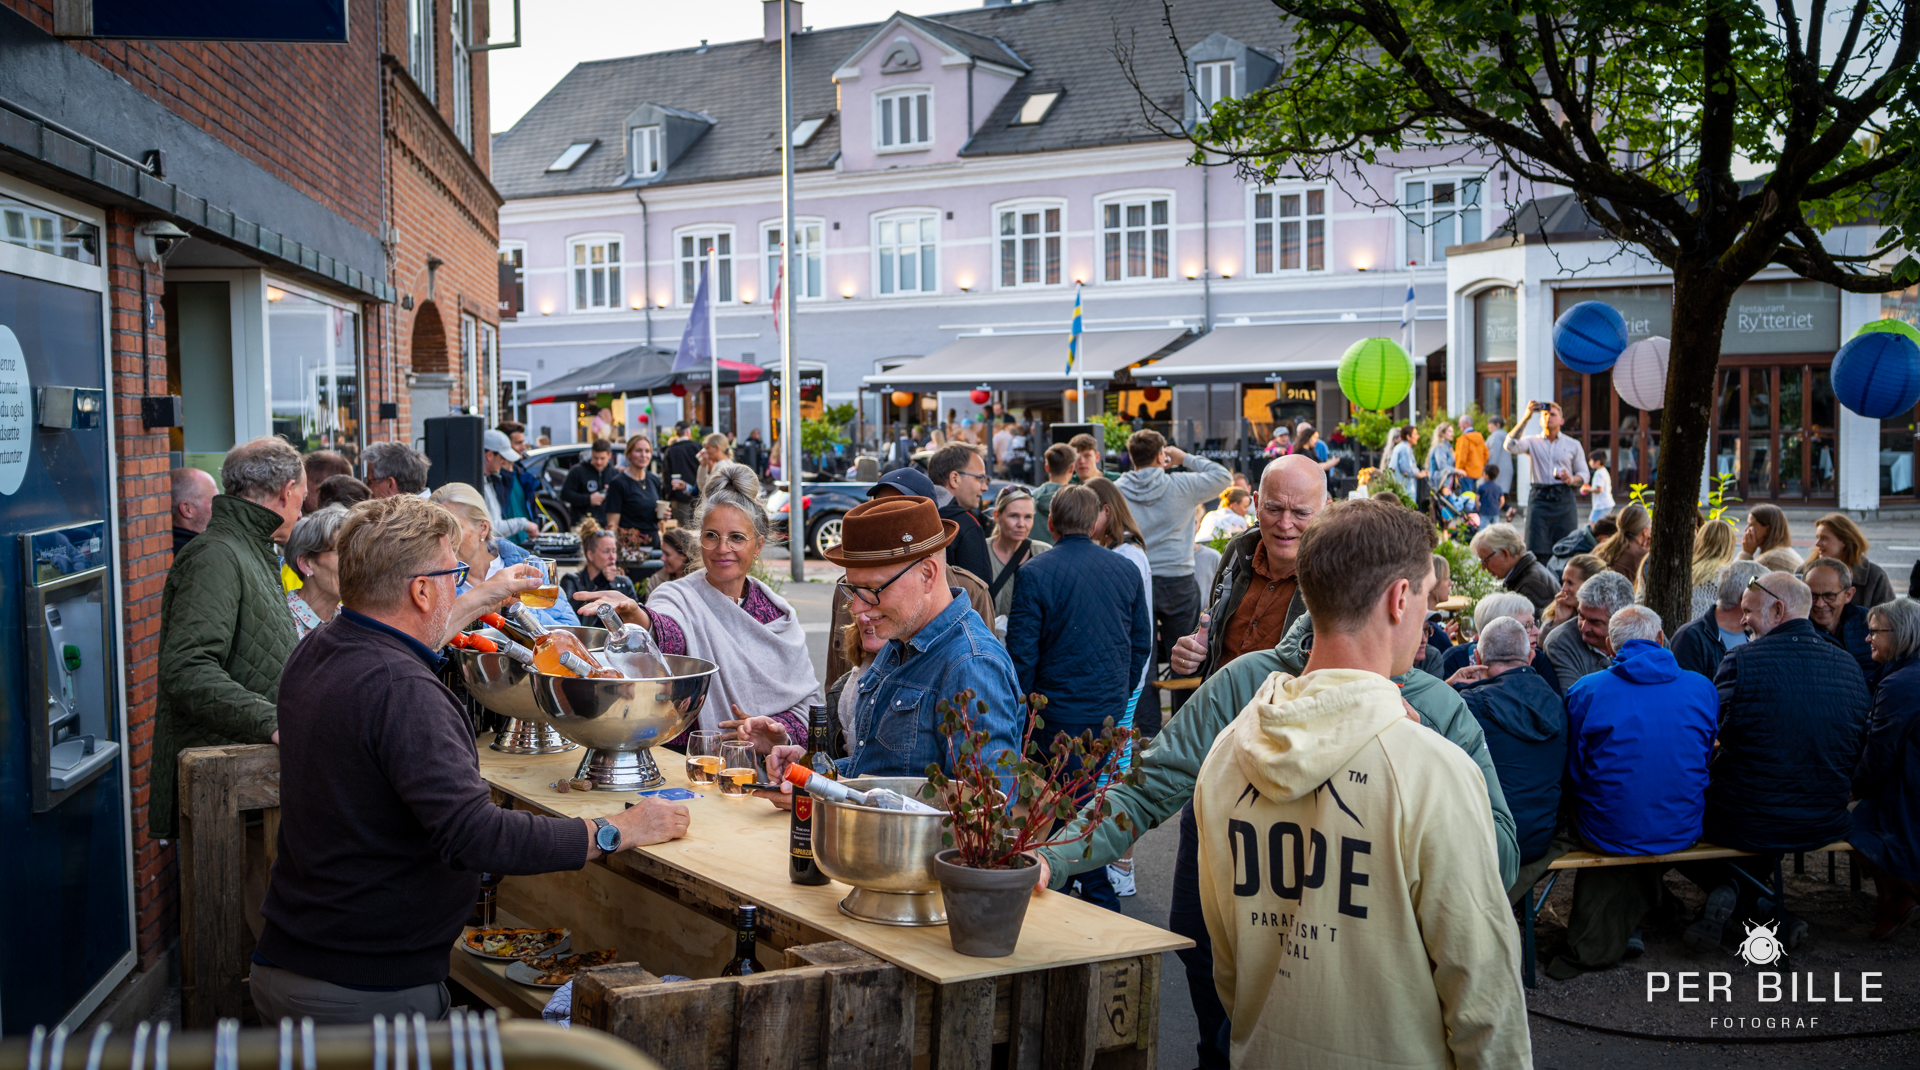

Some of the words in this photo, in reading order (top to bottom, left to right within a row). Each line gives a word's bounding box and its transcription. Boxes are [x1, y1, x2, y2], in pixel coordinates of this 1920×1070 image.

[1739, 304, 1785, 313] Restaurant
[0, 358, 16, 371] enne
[0, 380, 18, 394] tomat
[10, 401, 24, 422] også
[0, 424, 19, 441] dsætte
[0, 449, 23, 465] ntanter
[1348, 770, 1368, 785] TM
[1228, 818, 1371, 919] DOPE
